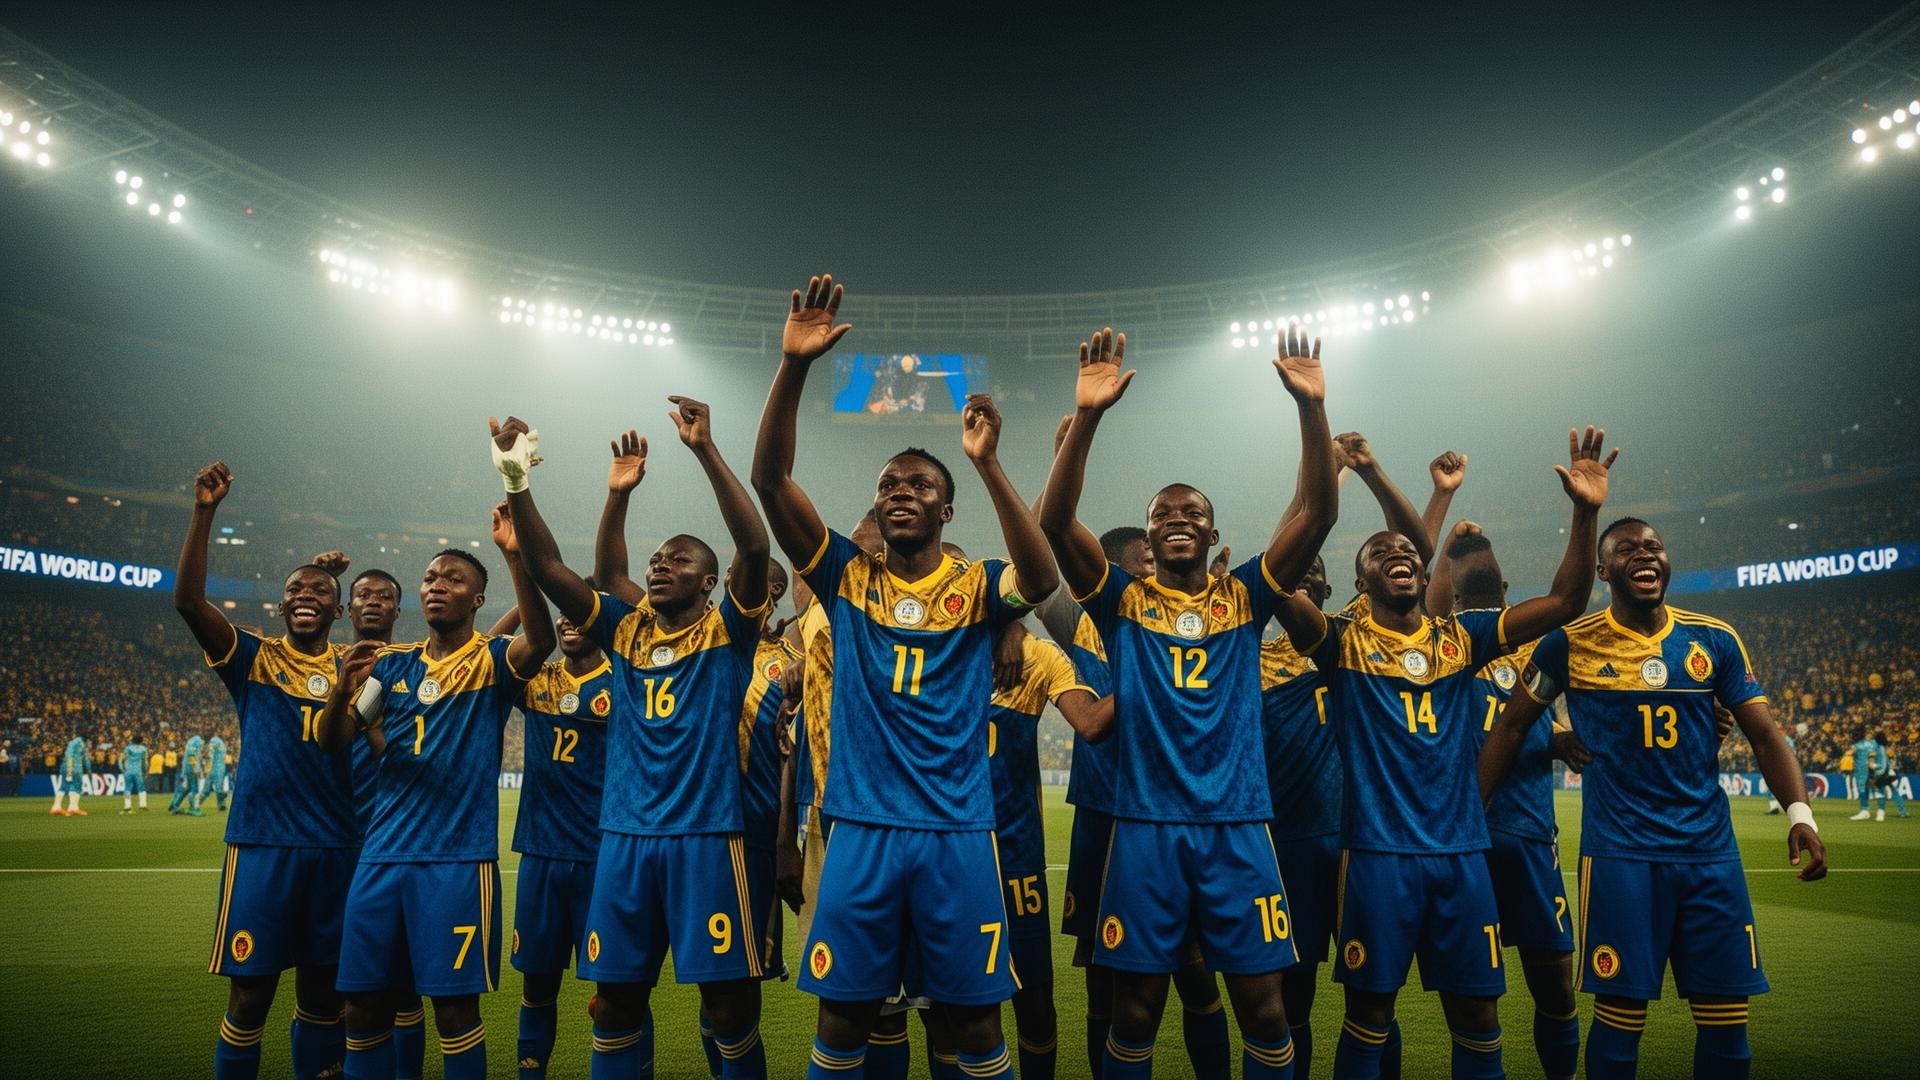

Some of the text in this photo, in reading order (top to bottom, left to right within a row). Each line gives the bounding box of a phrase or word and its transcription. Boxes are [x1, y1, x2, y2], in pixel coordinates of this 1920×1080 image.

[40, 553, 116, 583] WORLD
[119, 564, 162, 588] CUP
[1737, 547, 1899, 588] FIFA WORLD CUP
[892, 644, 925, 696] 11
[1169, 646, 1208, 689] 12
[644, 677, 676, 719] 16
[1399, 691, 1438, 733] 14
[1483, 694, 1506, 731] 1
[414, 715, 425, 755] 1
[552, 727, 579, 763] 12
[1637, 704, 1678, 749] 13
[1008, 875, 1042, 916] 15
[708, 913, 732, 954] 9
[1254, 894, 1289, 943] 16
[453, 925, 477, 969] 7
[980, 922, 1002, 974] 7
